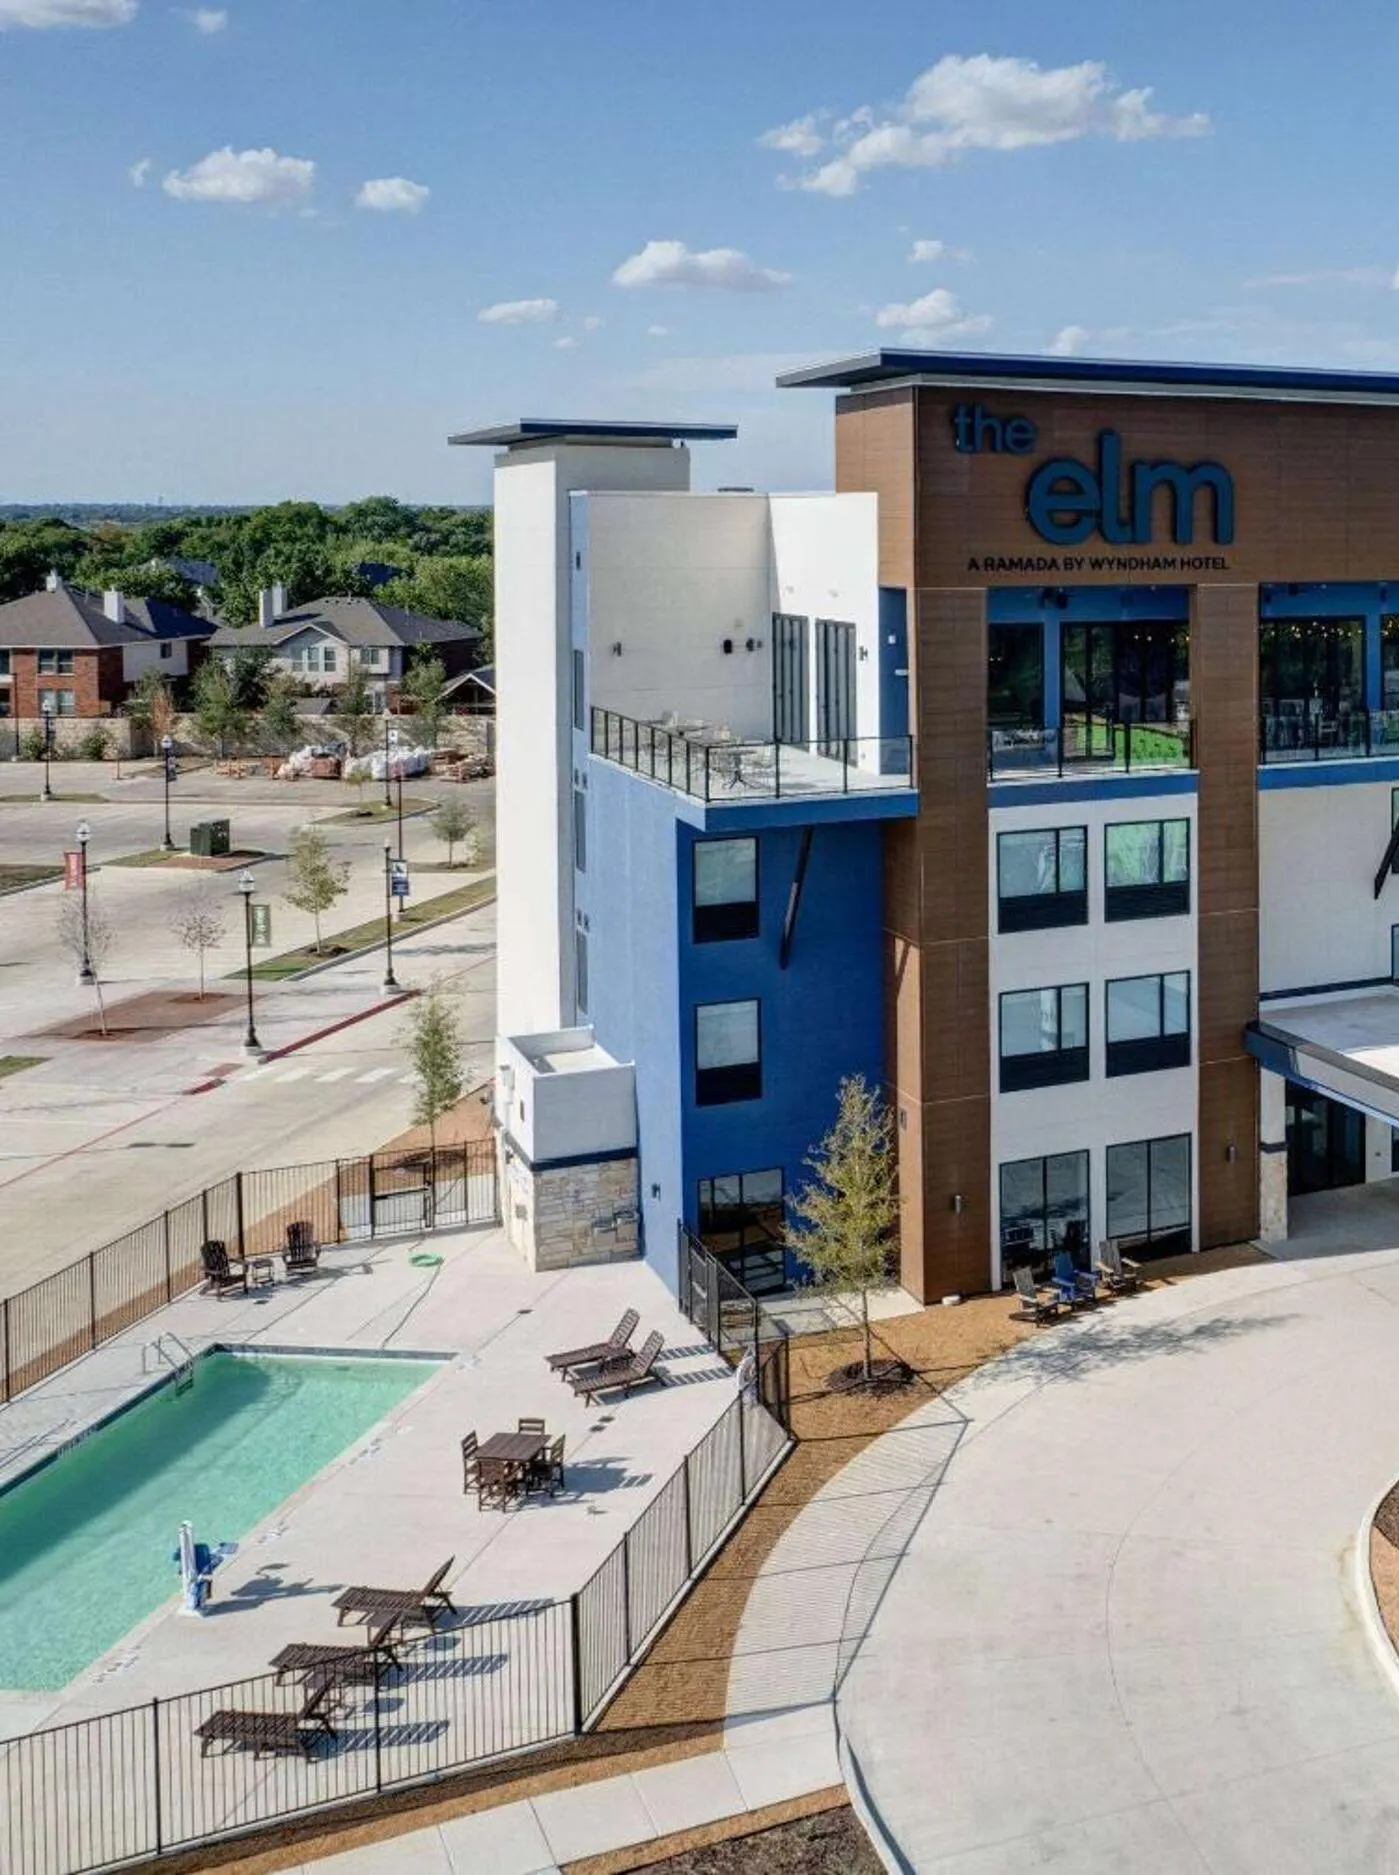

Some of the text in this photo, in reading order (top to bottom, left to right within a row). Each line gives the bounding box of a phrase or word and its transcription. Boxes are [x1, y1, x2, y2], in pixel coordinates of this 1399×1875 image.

[952, 403, 1037, 454] the
[1025, 427, 1235, 545] elm
[967, 556, 1229, 572] A RAMADA BY WYNDHAM HOTEL
